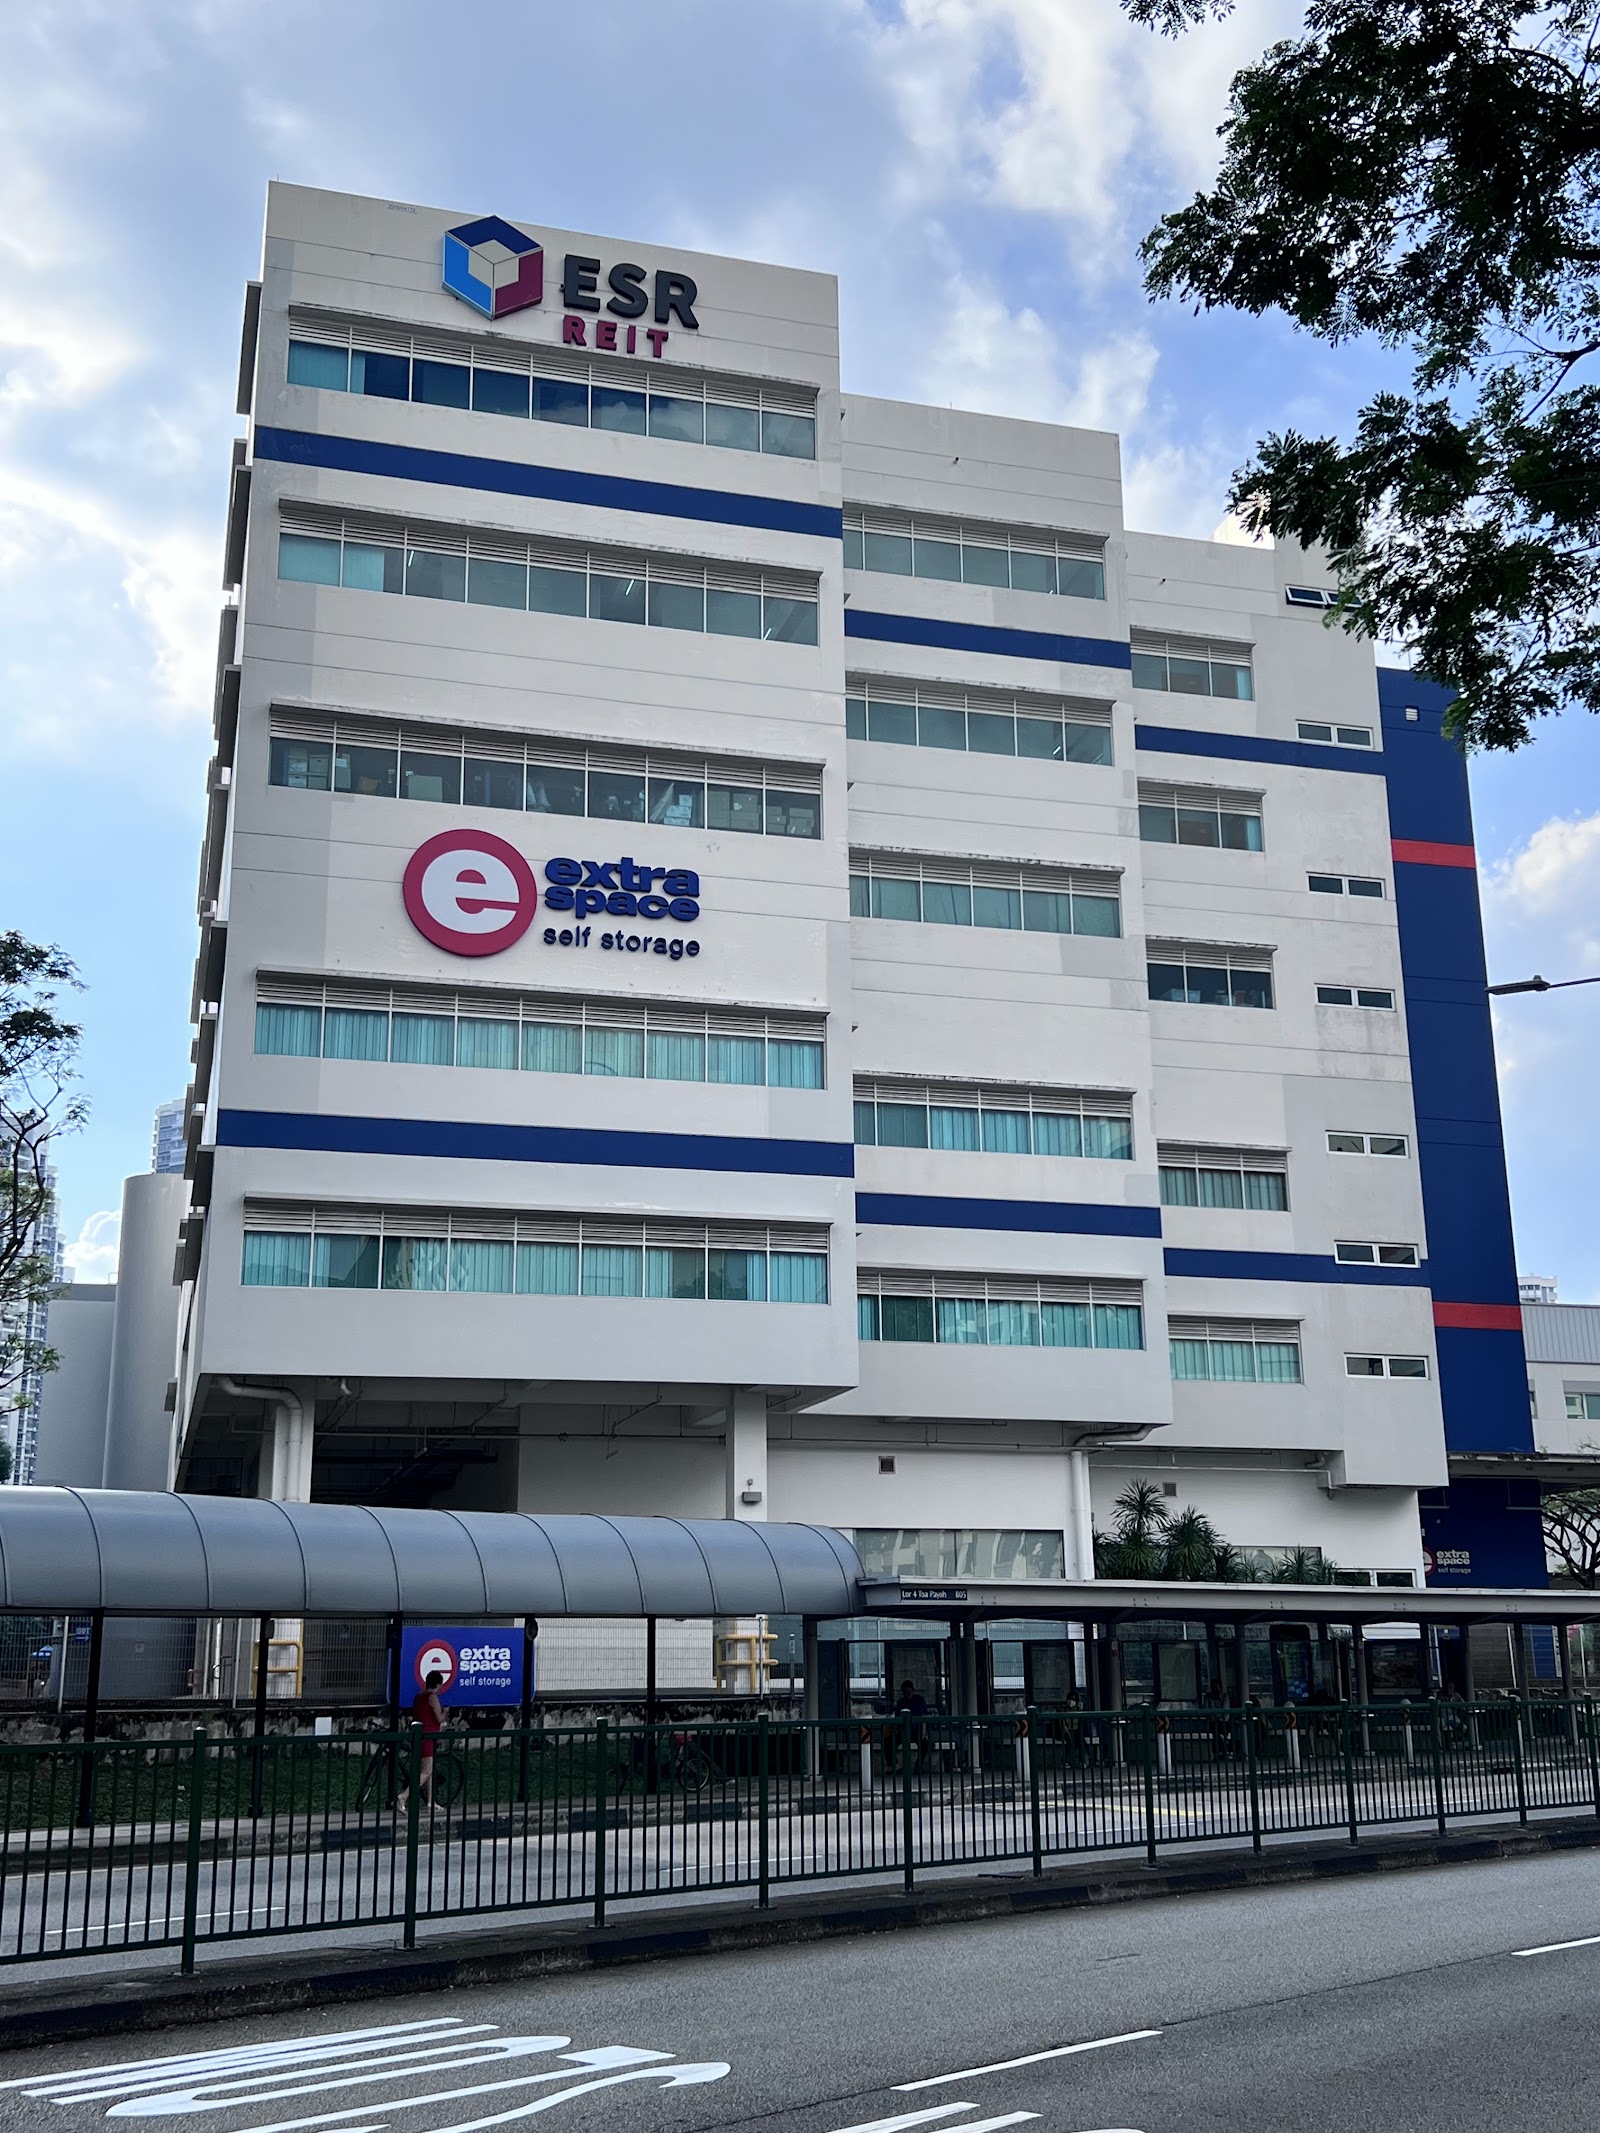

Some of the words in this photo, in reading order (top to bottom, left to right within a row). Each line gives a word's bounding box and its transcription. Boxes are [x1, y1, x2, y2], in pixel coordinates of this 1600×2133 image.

[562, 254, 699, 329] ESR
[563, 315, 669, 358] REIT
[545, 857, 700, 897] extra
[544, 885, 700, 922] space
[543, 926, 591, 948] self
[600, 930, 700, 960] storage
[1436, 1549, 1470, 1559] extra
[1437, 1558, 1470, 1566] space
[902, 1590, 911, 1598] Lor
[912, 1590, 917, 1598] 4
[918, 1590, 928, 1598] Toa
[929, 1590, 947, 1600] Payoh
[460, 1645, 511, 1660] extra
[460, 1660, 511, 1674] space
[460, 1676, 476, 1686] self
[478, 1677, 511, 1687] storage
